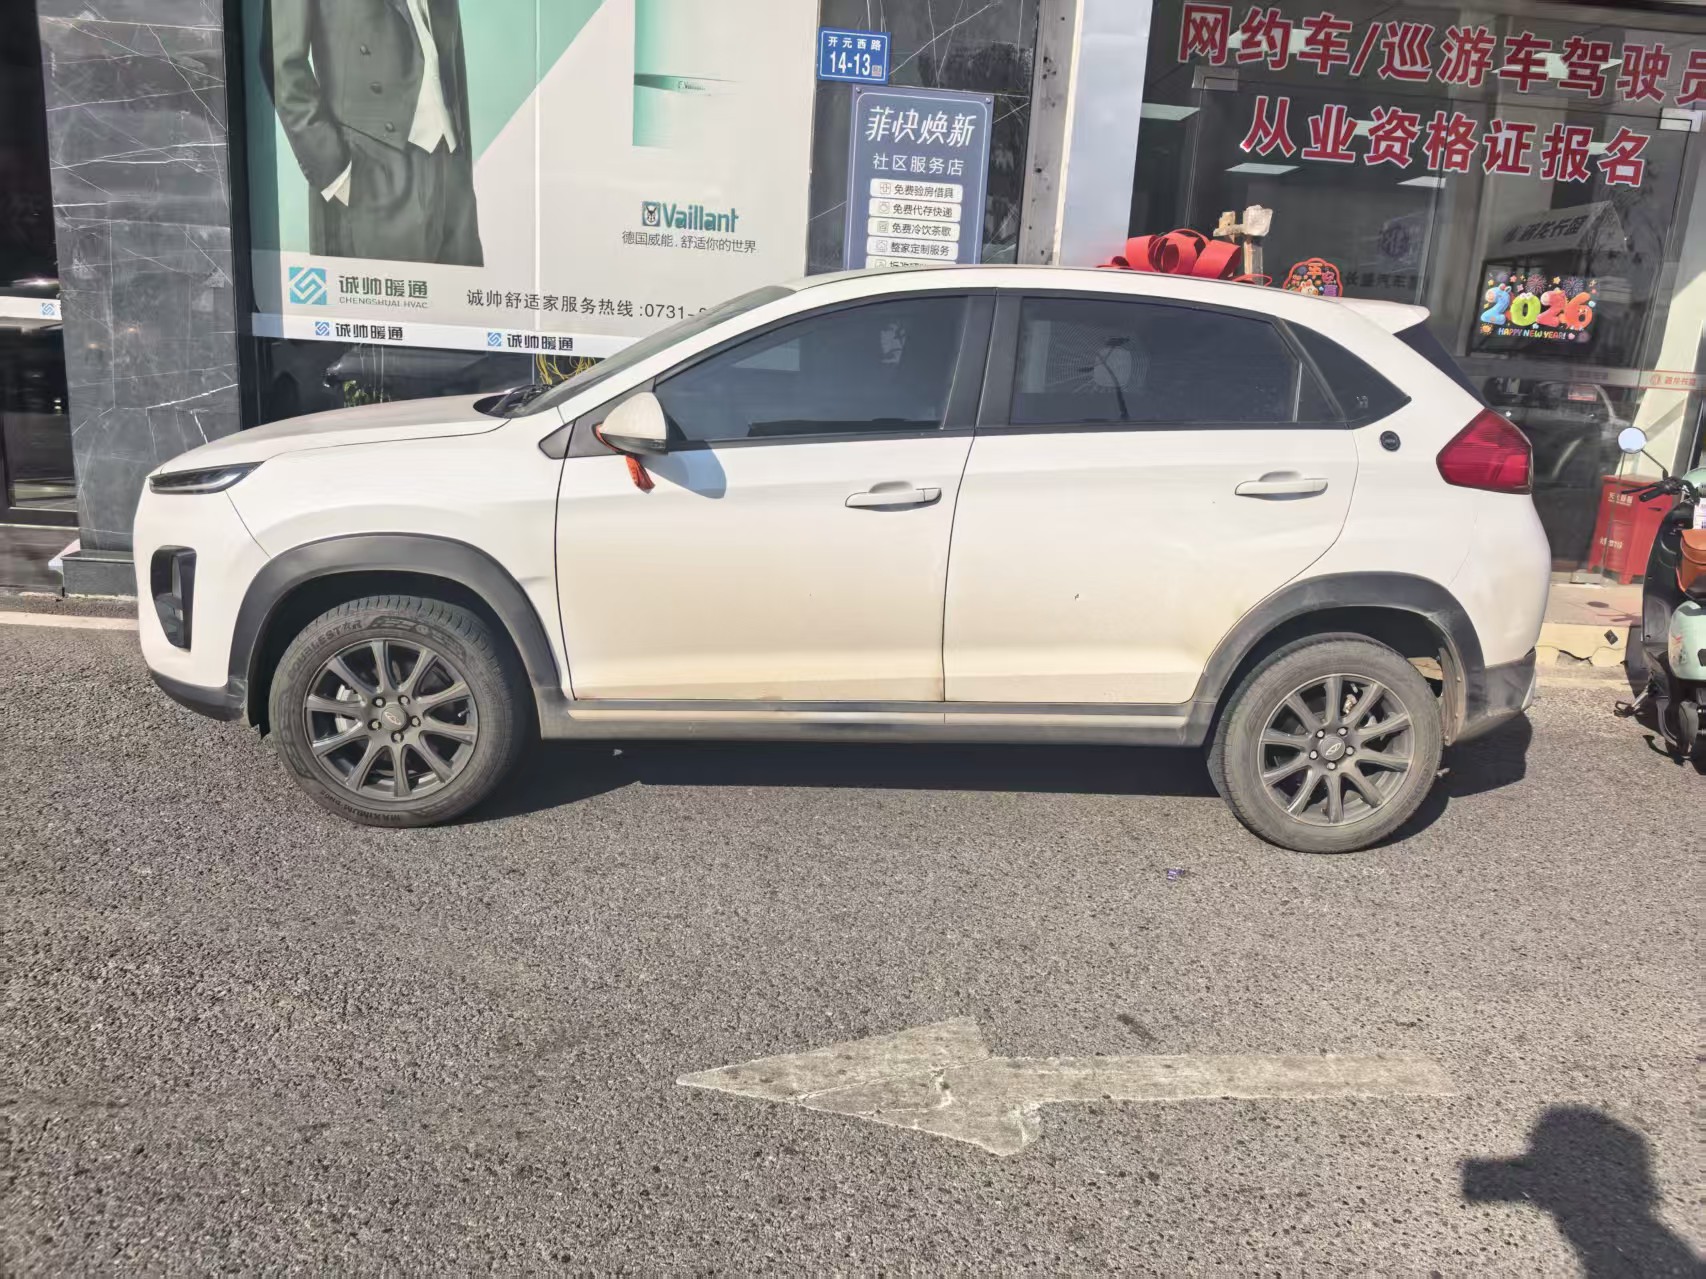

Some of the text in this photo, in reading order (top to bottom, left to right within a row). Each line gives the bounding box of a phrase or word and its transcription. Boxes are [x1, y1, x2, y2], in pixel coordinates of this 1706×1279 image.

[828, 36, 882, 51] 开元西路
[830, 51, 871, 76] 14-13
[866, 105, 977, 147] 菲快焕新
[1240, 95, 1651, 187] 从业资格证报名
[872, 153, 965, 176] 社区服务店
[662, 202, 739, 233] Vaillant
[893, 203, 953, 218] 免费代存快递
[891, 242, 950, 256] 整家定制服务
[339, 275, 429, 299] 诚帅暖通
[403, 299, 429, 309] HVAC
[466, 289, 706, 320] 诚帅舒适家服务热线:0731-
[1481, 284, 1592, 330] 2026
[335, 322, 403, 341] 诚帅暖通
[507, 333, 574, 351] 诚帅暖通
[1498, 327, 1566, 340] HAPPY NEW YEAR!
